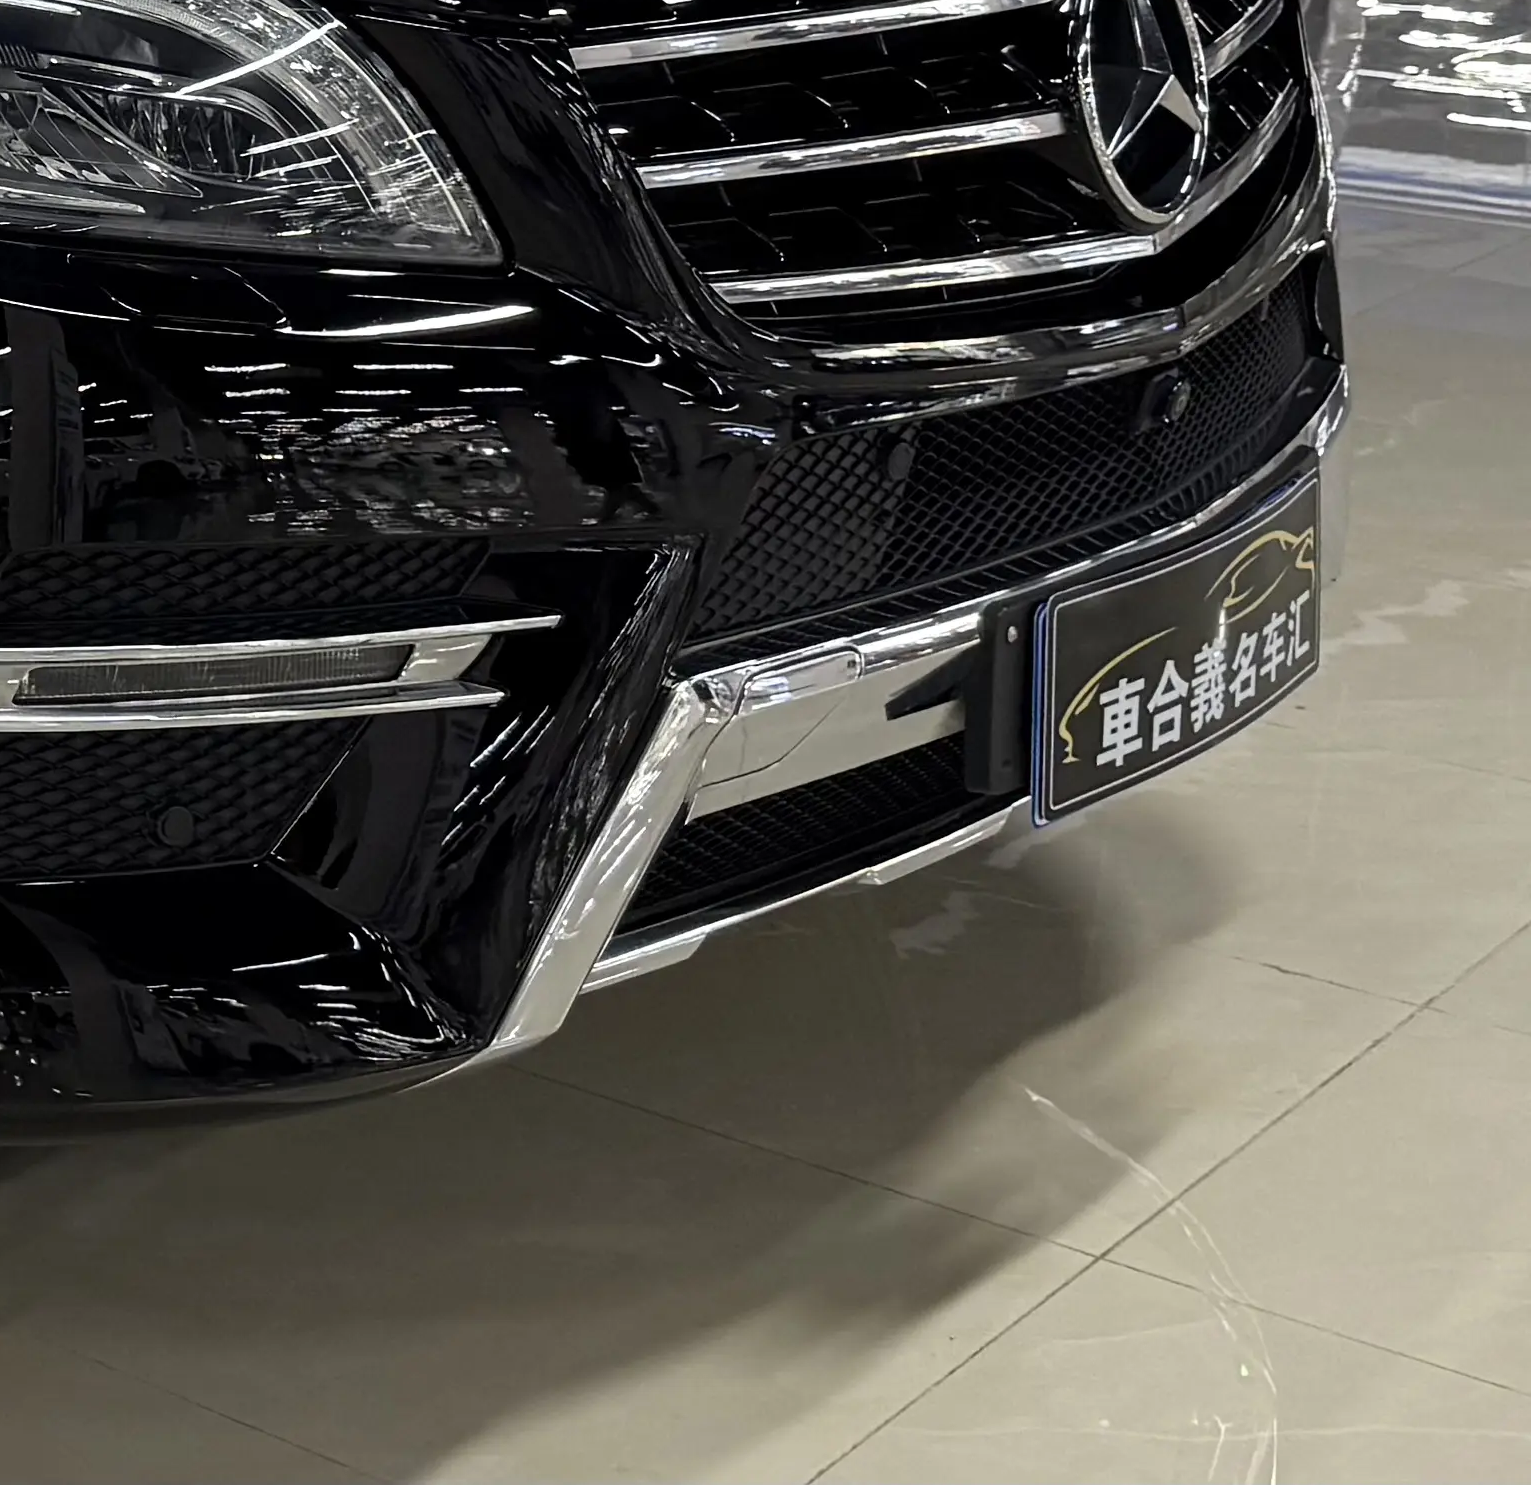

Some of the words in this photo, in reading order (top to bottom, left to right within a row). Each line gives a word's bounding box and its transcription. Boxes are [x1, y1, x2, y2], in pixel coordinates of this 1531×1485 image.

[1095, 590, 1311, 768] 車合義名车汇
